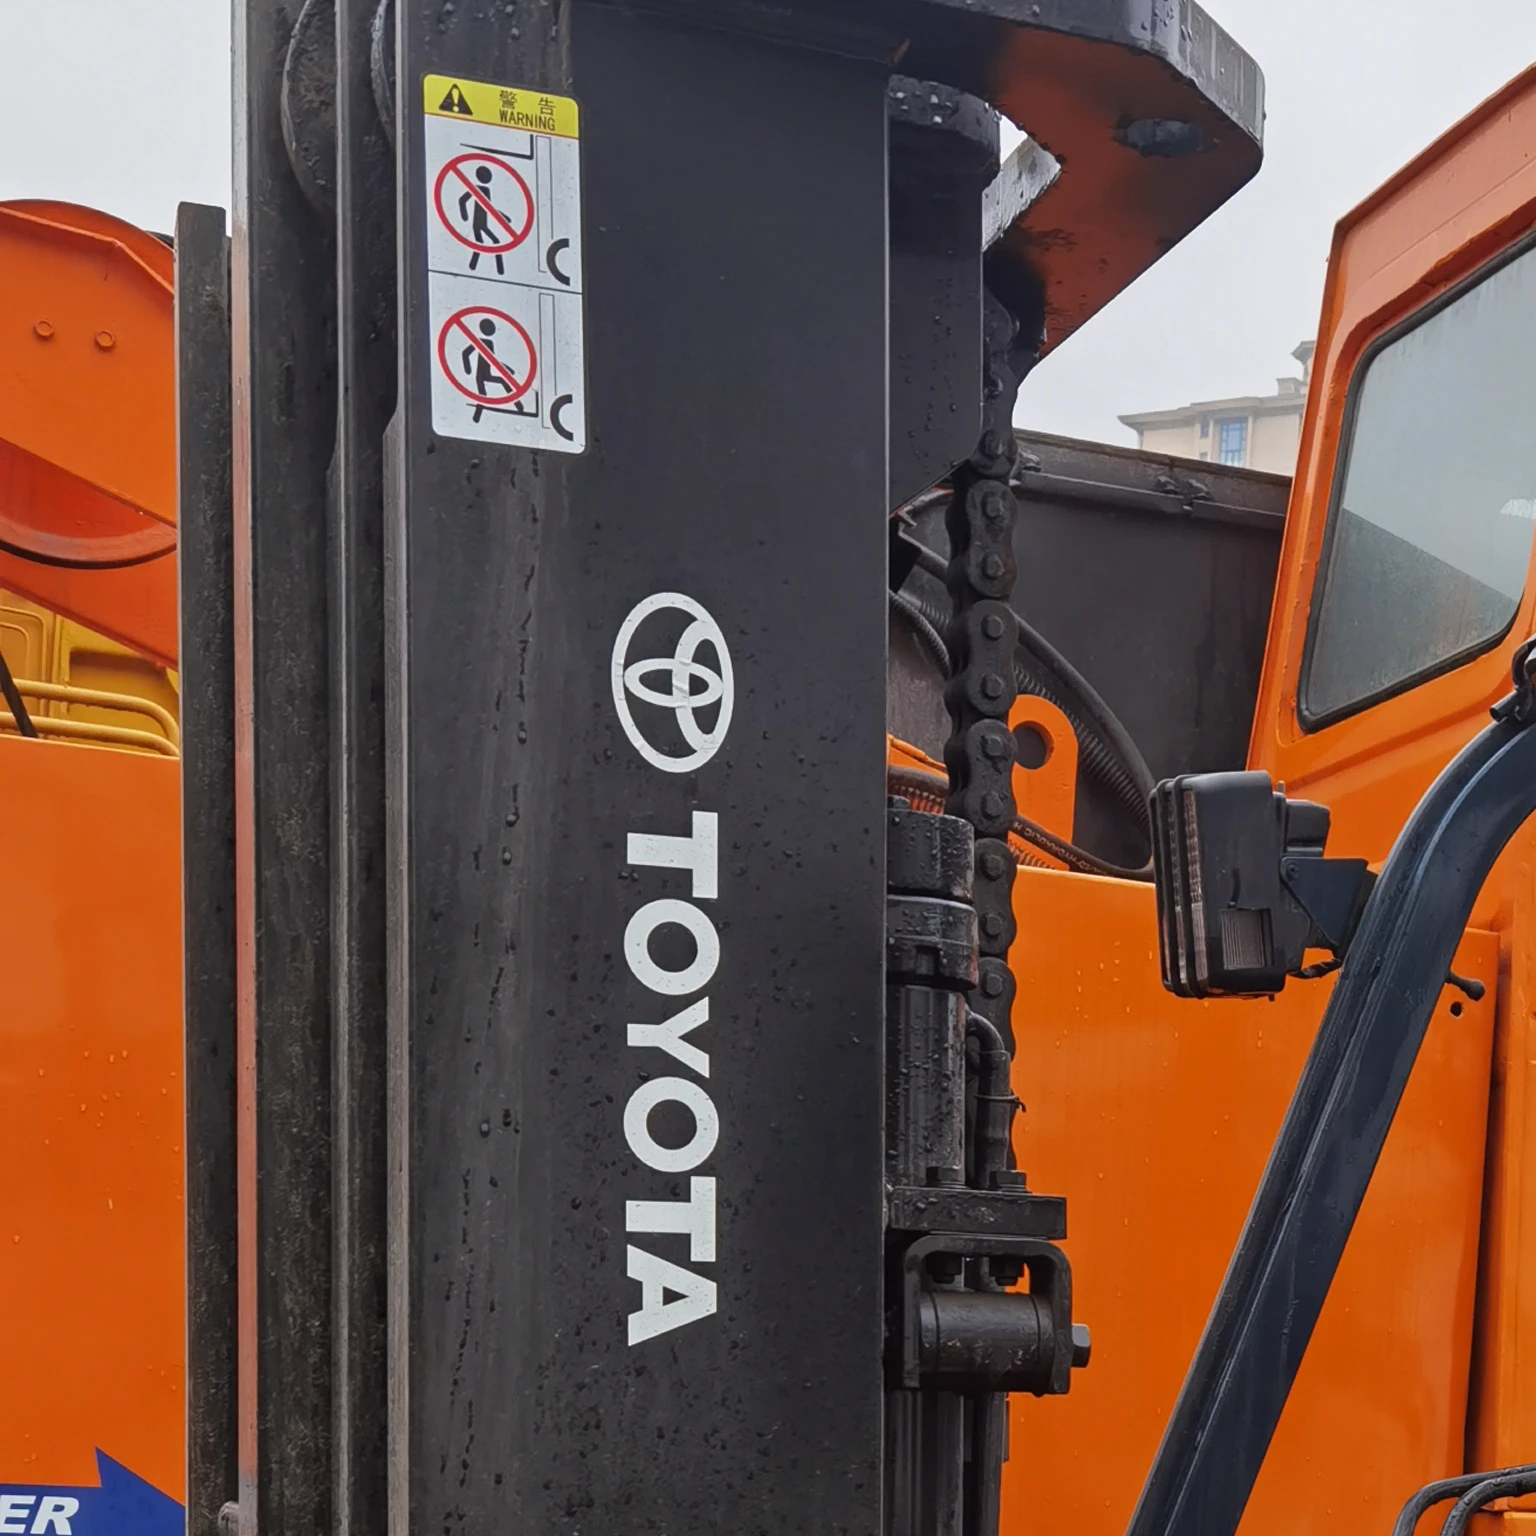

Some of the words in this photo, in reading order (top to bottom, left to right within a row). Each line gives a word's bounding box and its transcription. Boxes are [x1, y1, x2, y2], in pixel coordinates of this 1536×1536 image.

[499, 89, 556, 116] 警告
[499, 108, 555, 131] WARNING
[623, 811, 720, 1347] TOYOTA
